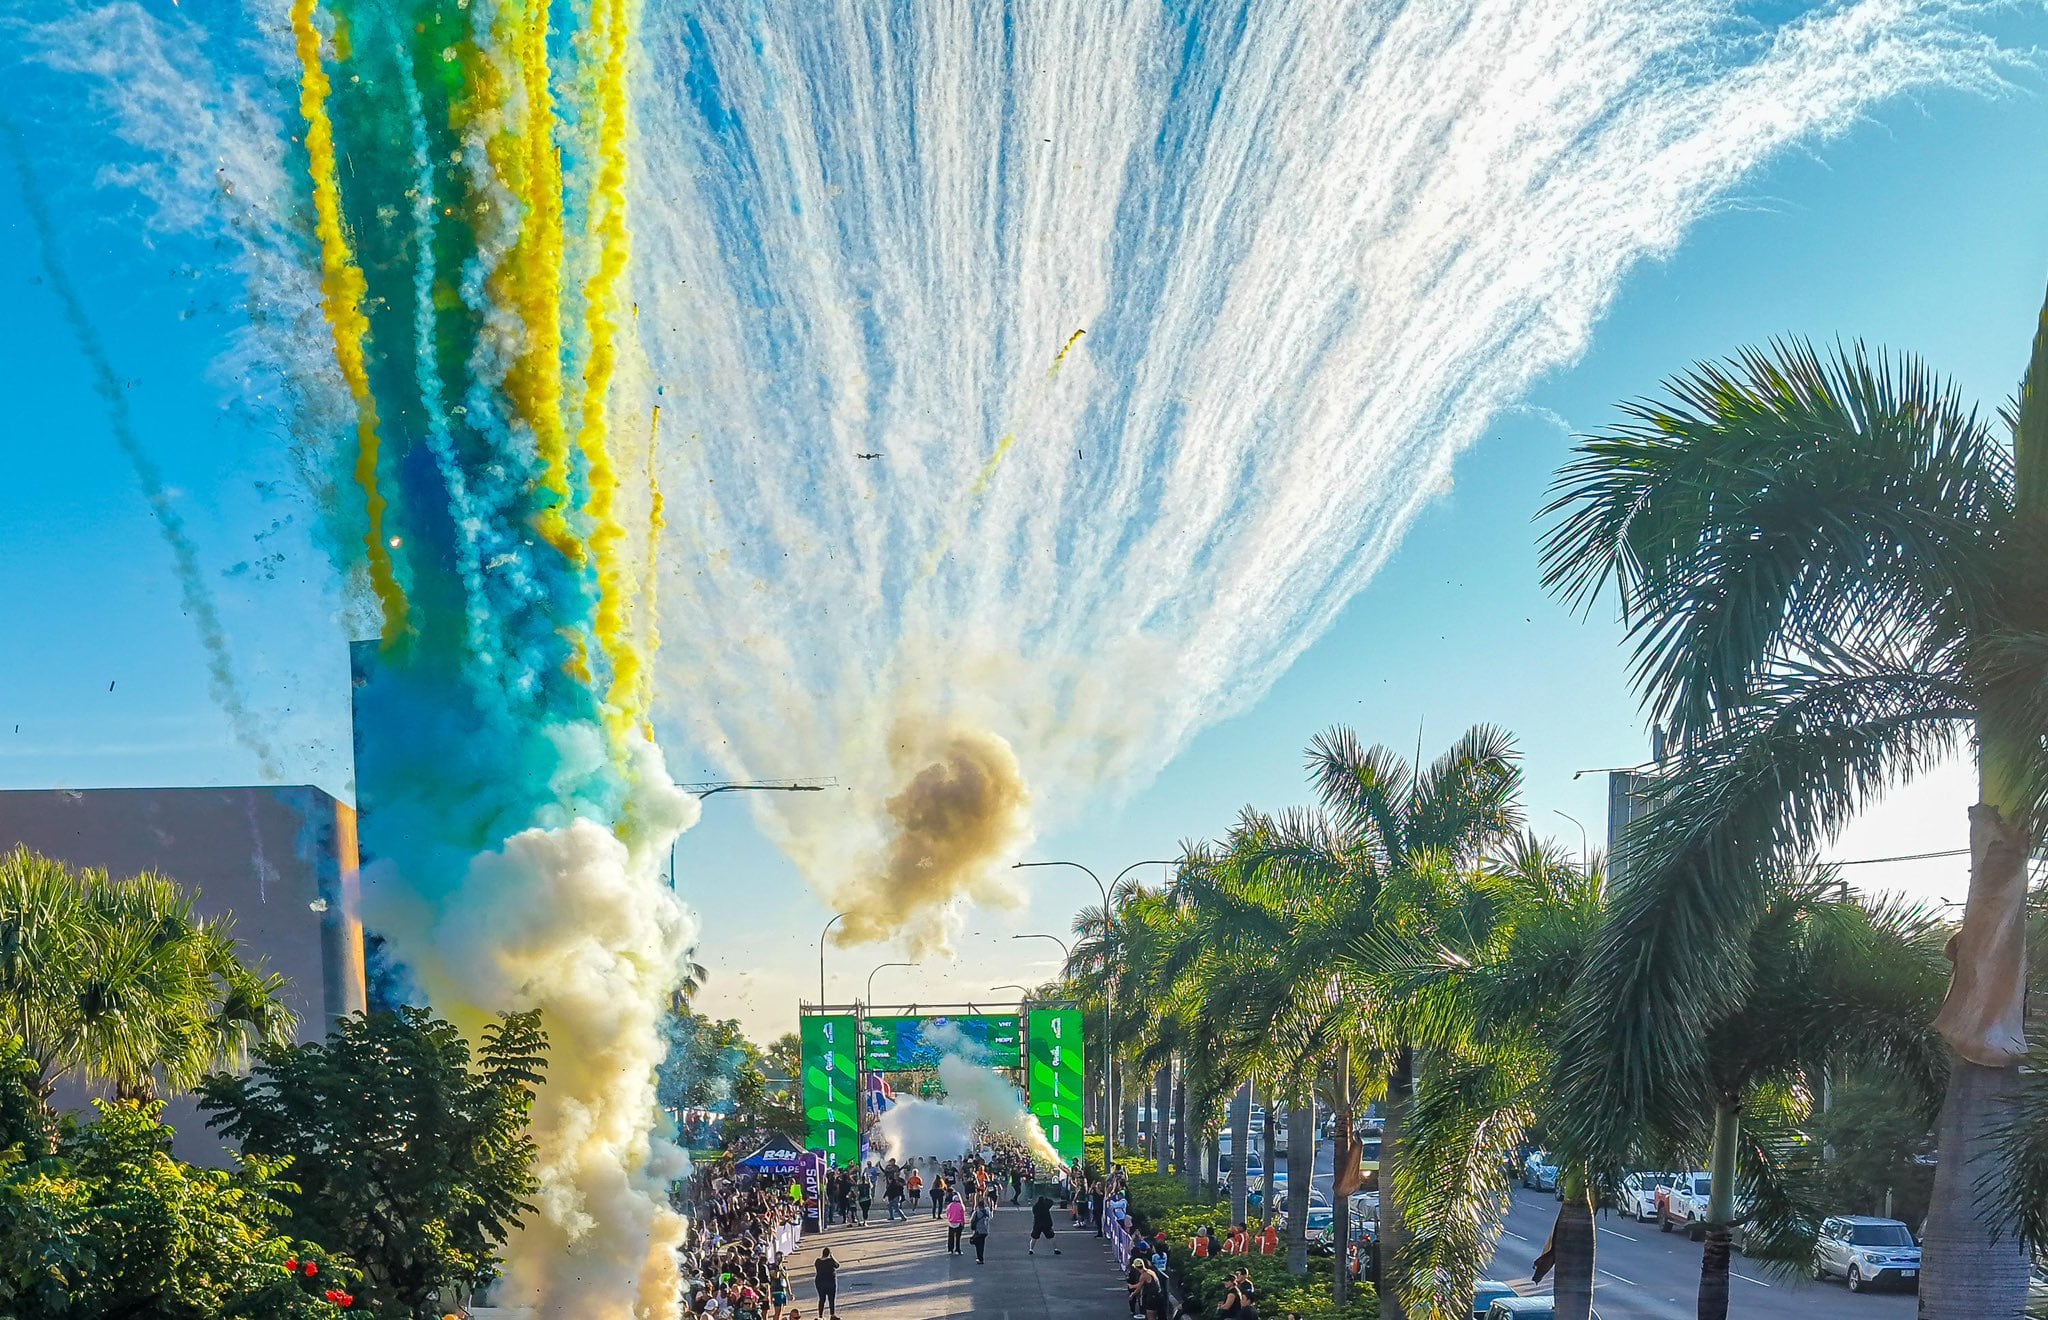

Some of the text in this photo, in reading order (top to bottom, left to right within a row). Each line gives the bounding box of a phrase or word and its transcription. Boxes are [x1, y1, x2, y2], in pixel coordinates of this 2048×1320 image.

[763, 1150, 796, 1160] R4H
[759, 1165, 800, 1173] MLAPS
[807, 1169, 819, 1218] MYLAPS
